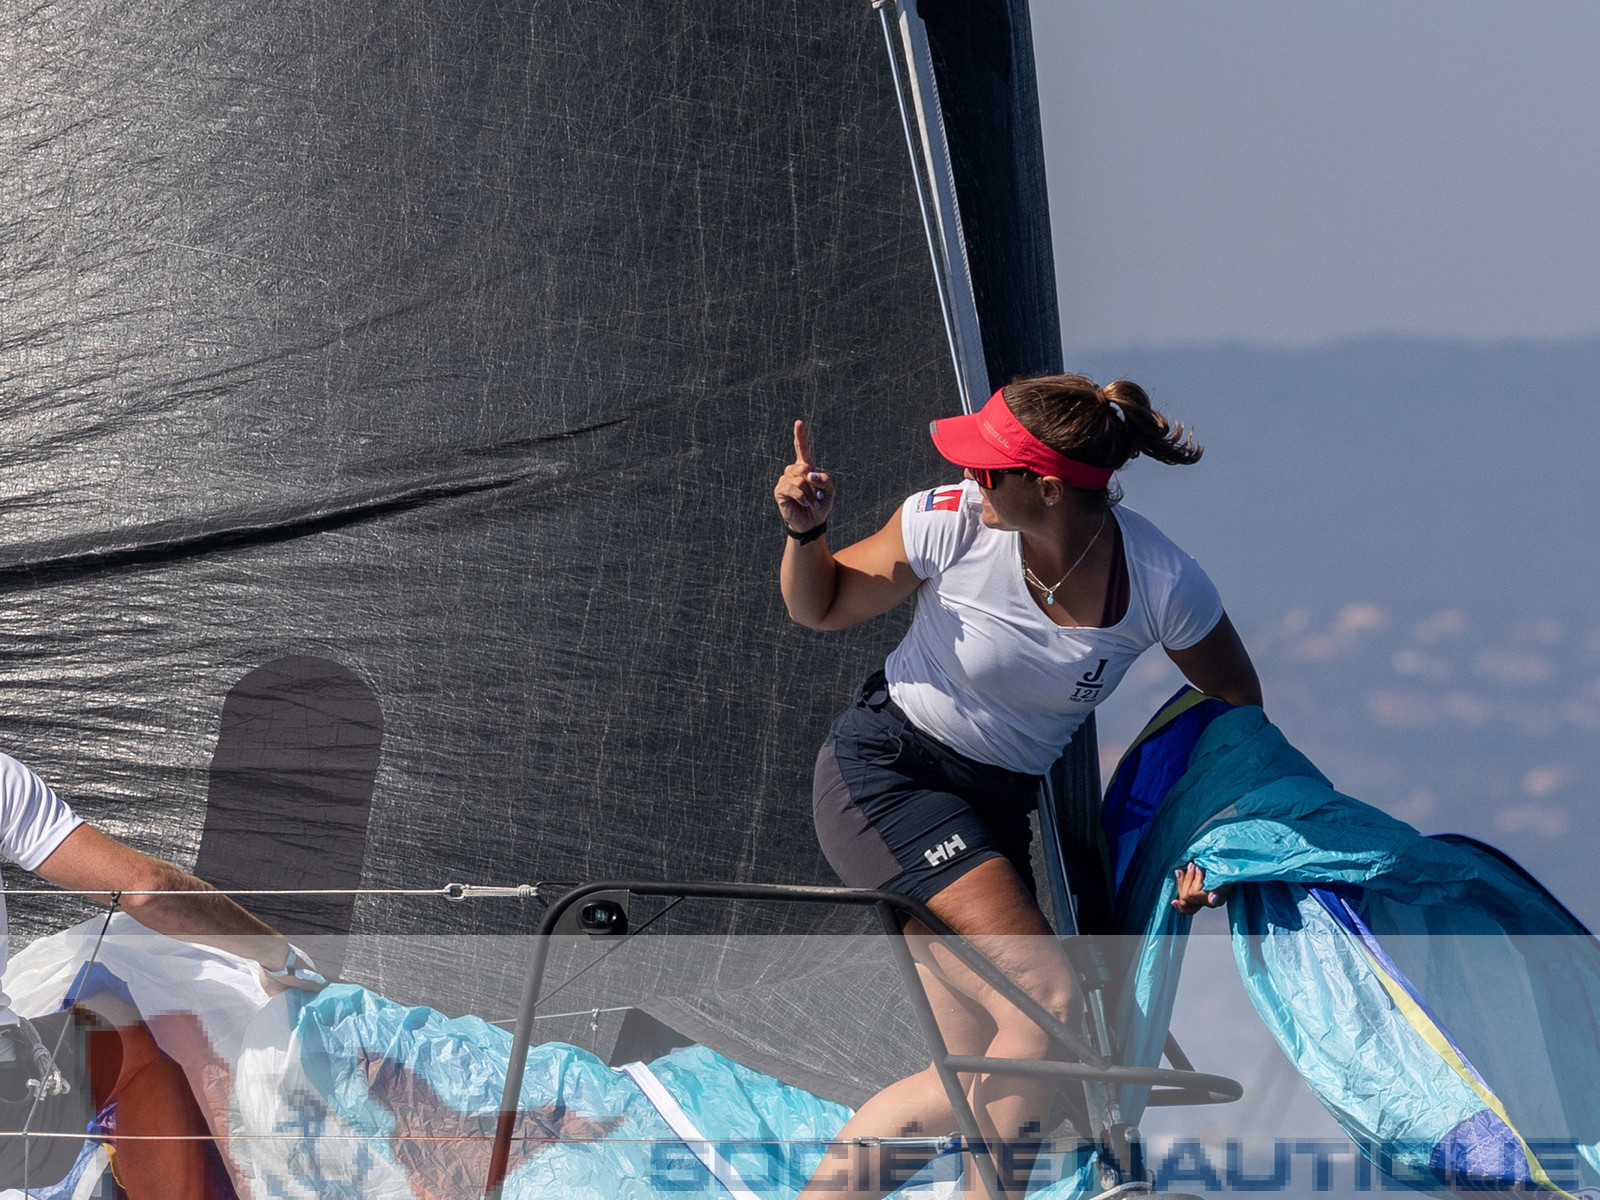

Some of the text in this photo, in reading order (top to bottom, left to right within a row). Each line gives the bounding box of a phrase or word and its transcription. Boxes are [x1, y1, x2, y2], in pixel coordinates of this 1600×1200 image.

[1083, 659, 1109, 682] J
[1072, 687, 1101, 699] 121
[924, 834, 967, 867] HH
